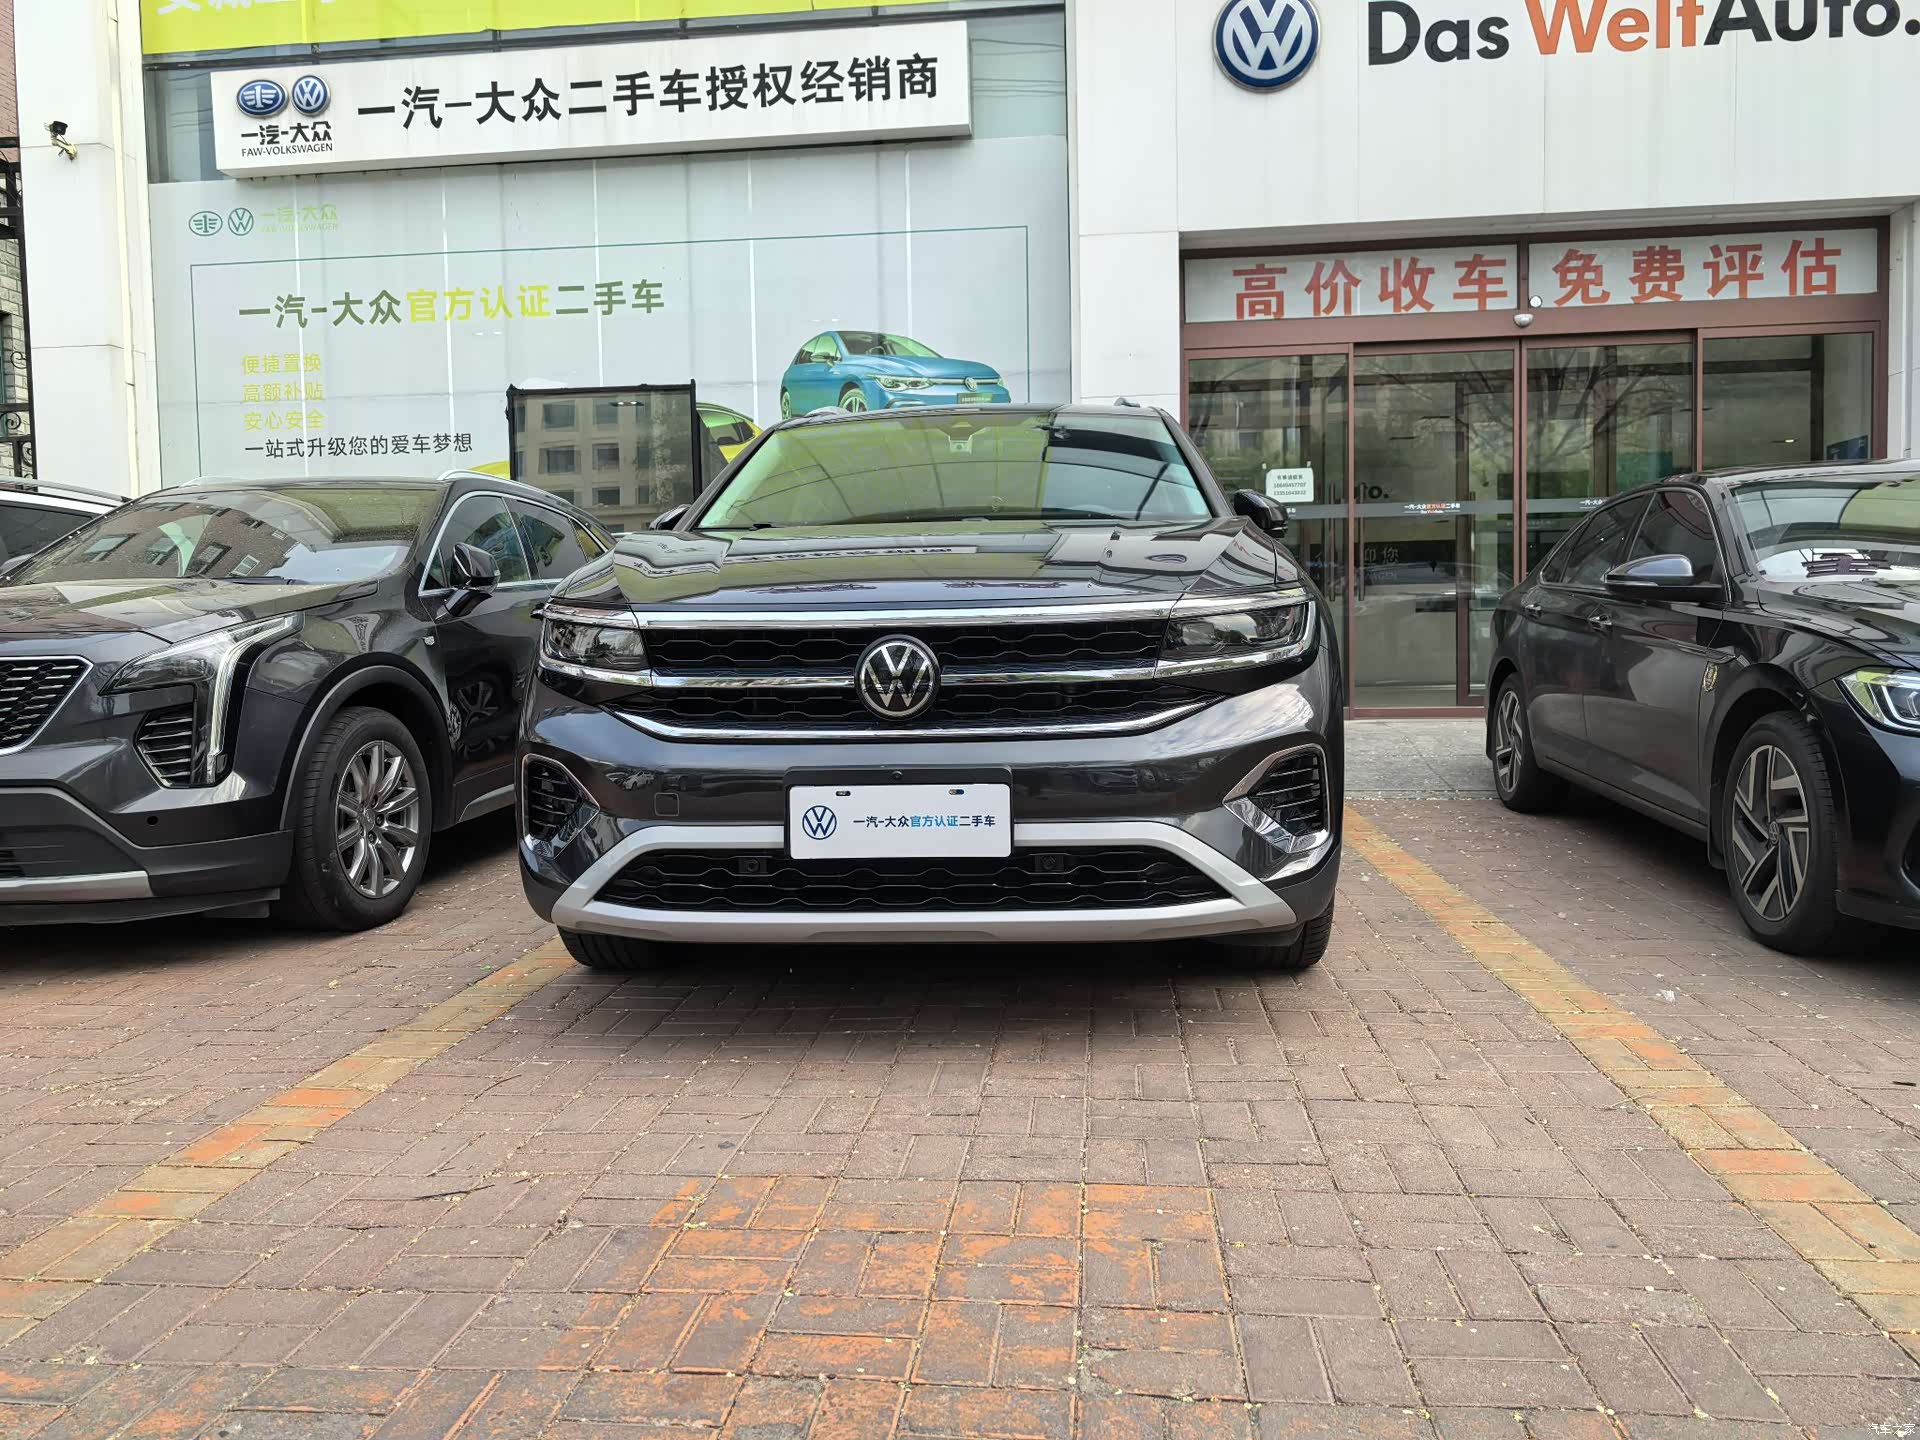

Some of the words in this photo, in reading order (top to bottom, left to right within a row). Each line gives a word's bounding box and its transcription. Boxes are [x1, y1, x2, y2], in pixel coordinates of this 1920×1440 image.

[1368, 0, 1510, 66] Das
[357, 52, 940, 130] 一汽-大众二手车授权经销商
[241, 121, 332, 145] 一汽-大众
[241, 143, 333, 157] FAW-VOLKSWAGEN
[1552, 237, 1842, 308] 免费评估
[1232, 253, 1508, 321] 高价收车
[239, 279, 666, 330] 一汽-大众官方认证二手车
[242, 353, 321, 375] 便捷置换
[242, 381, 324, 403] 高额补贴
[243, 408, 325, 432] 安心安全
[245, 432, 473, 459] 一站式升级您的爱车梦想
[853, 815, 996, 829] 一汽-大众官方认证二手车
